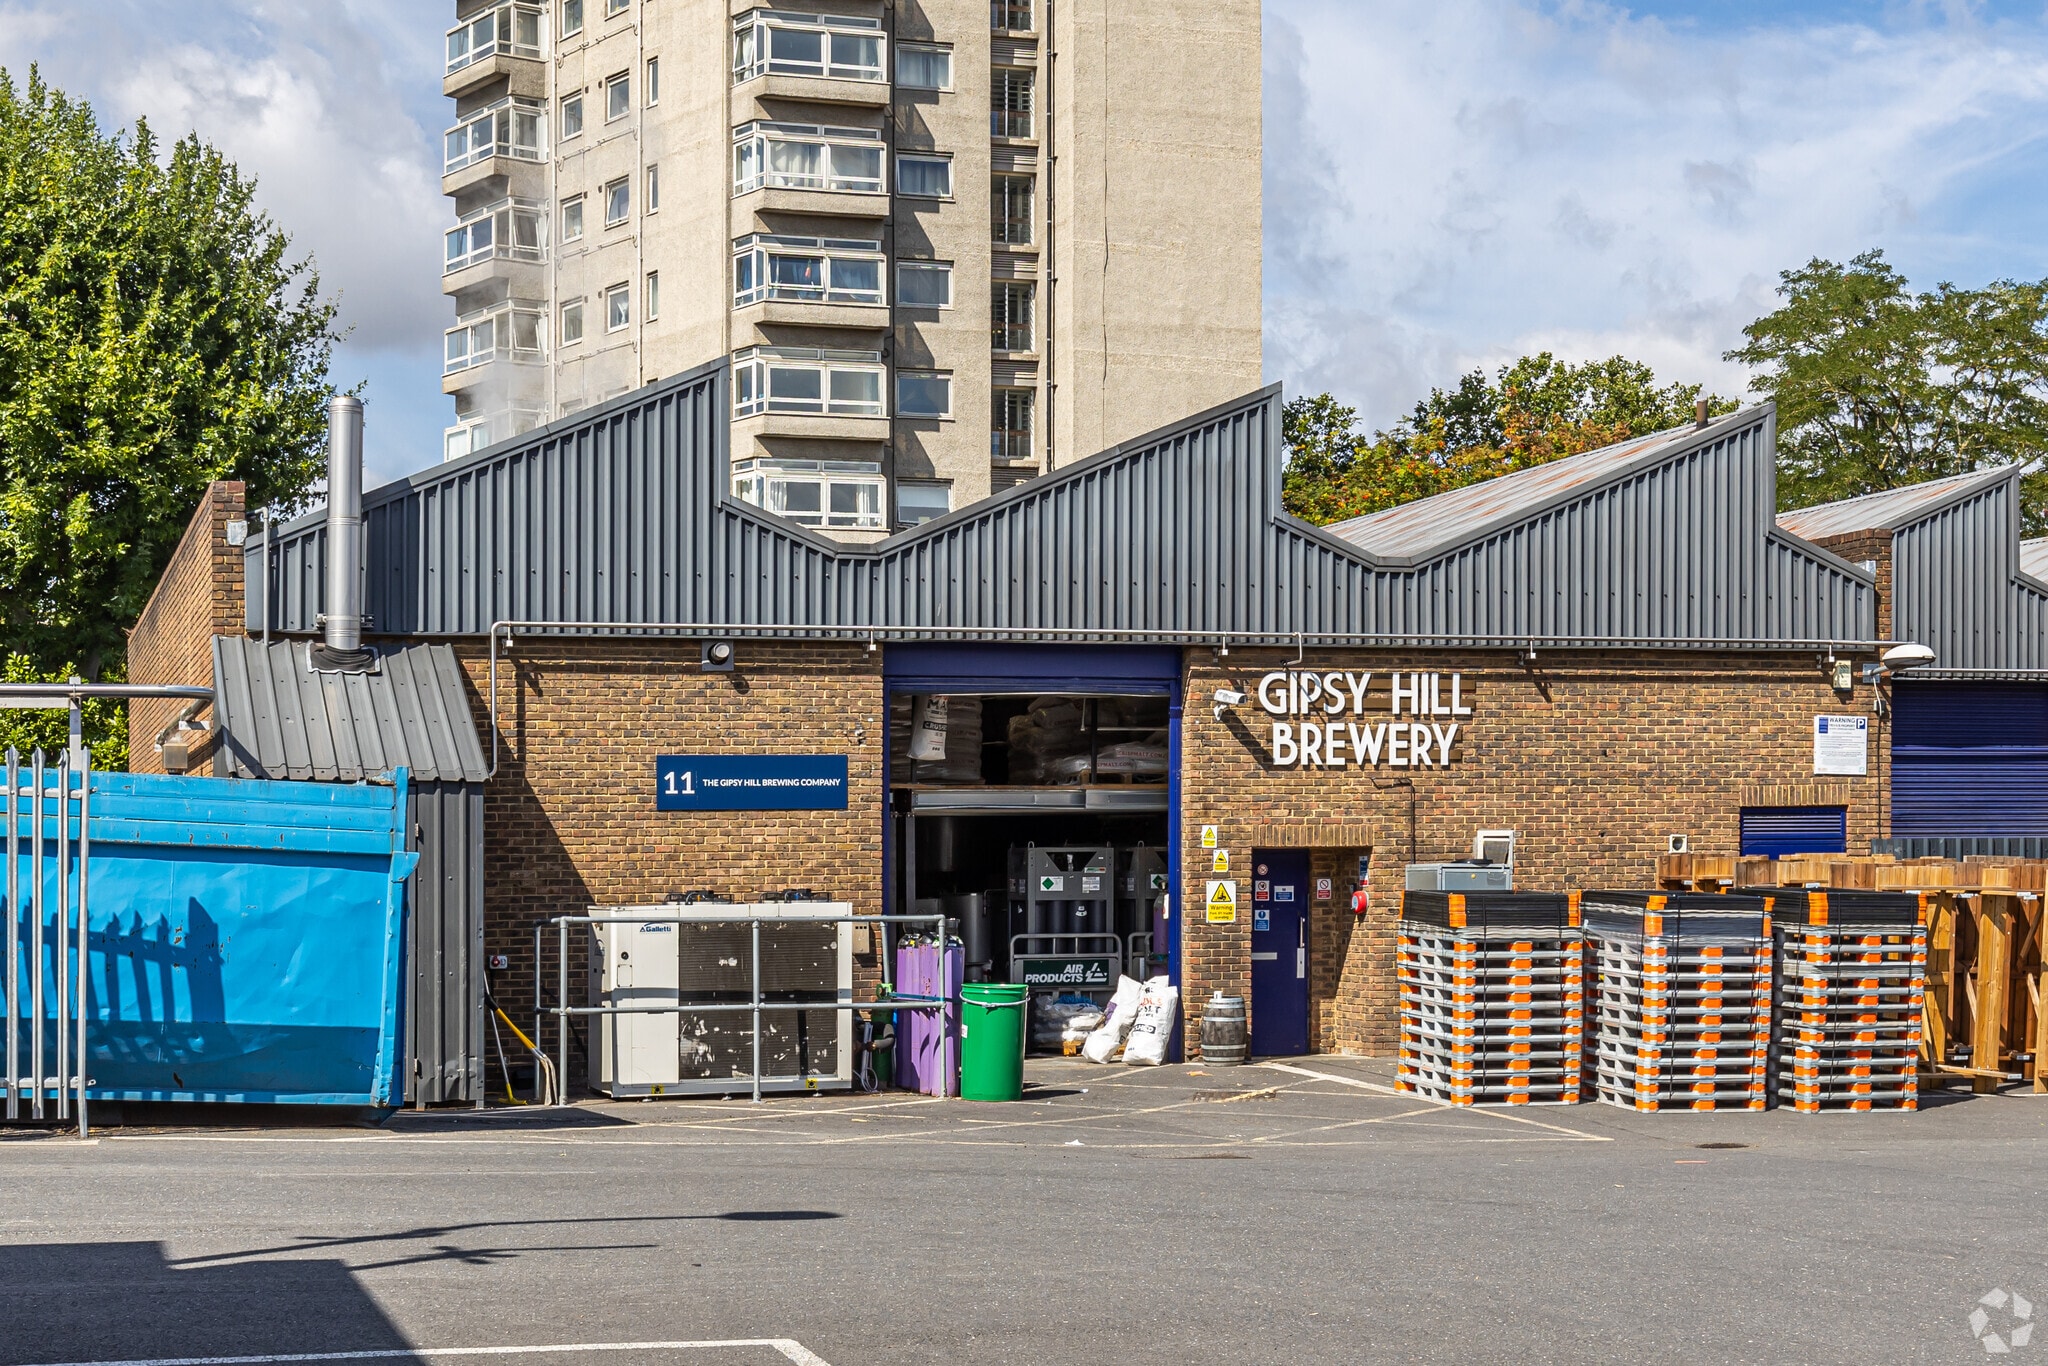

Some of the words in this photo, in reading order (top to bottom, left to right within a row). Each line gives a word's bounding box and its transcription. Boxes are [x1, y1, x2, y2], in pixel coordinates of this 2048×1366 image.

[1258, 672, 1371, 714] GIPSY
[1392, 672, 1472, 714] HILL
[1272, 722, 1459, 766] BREWERY
[664, 771, 695, 795] 11
[702, 778, 719, 787] THE
[719, 778, 743, 787] GIPSY
[744, 778, 761, 787] HILL
[762, 778, 800, 787] BREWING
[800, 778, 841, 787] COMPANY
[1063, 964, 1085, 973] AIR
[1025, 973, 1084, 983] PRODUCTS
